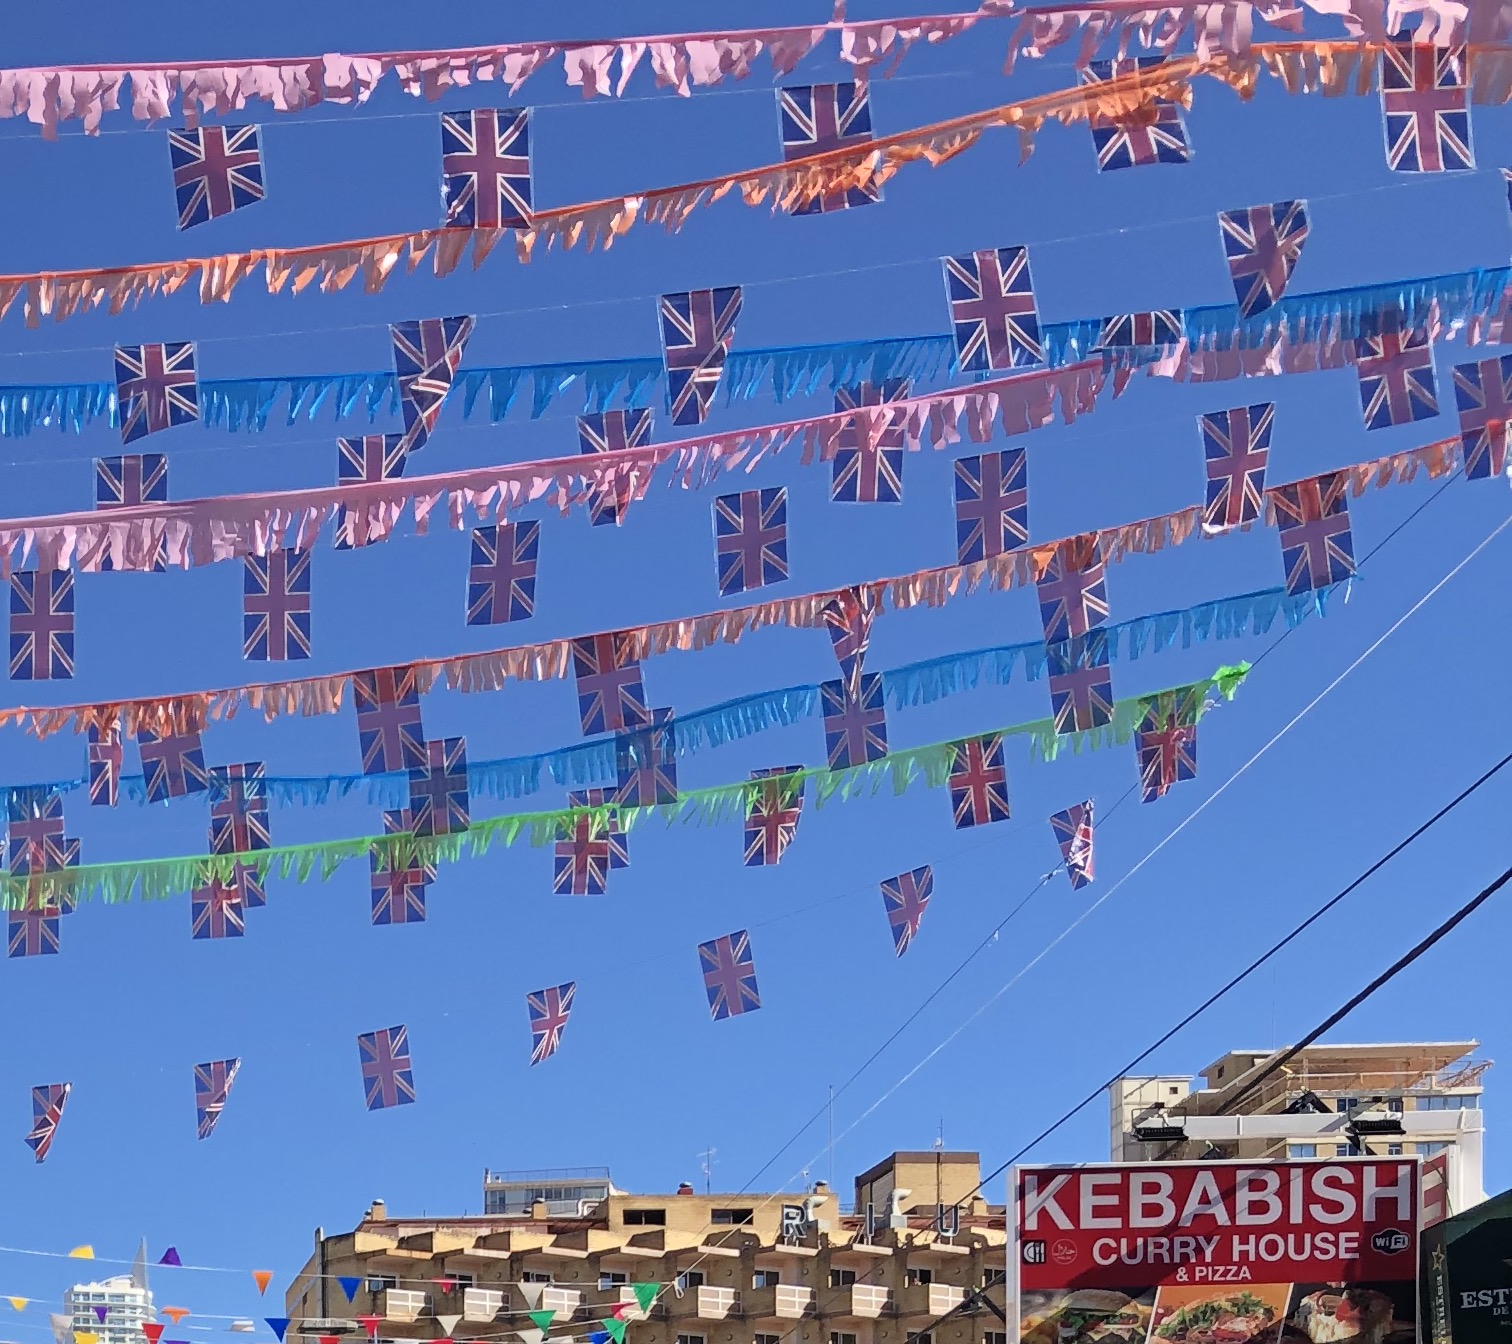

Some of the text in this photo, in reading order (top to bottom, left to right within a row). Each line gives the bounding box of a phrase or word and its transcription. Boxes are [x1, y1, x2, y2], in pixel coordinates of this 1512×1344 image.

[1024, 1165, 1412, 1231] KEBABISH
[1092, 1232, 1360, 1267] CURRY HOUSE
[1176, 1265, 1252, 1282] & PIZZA
